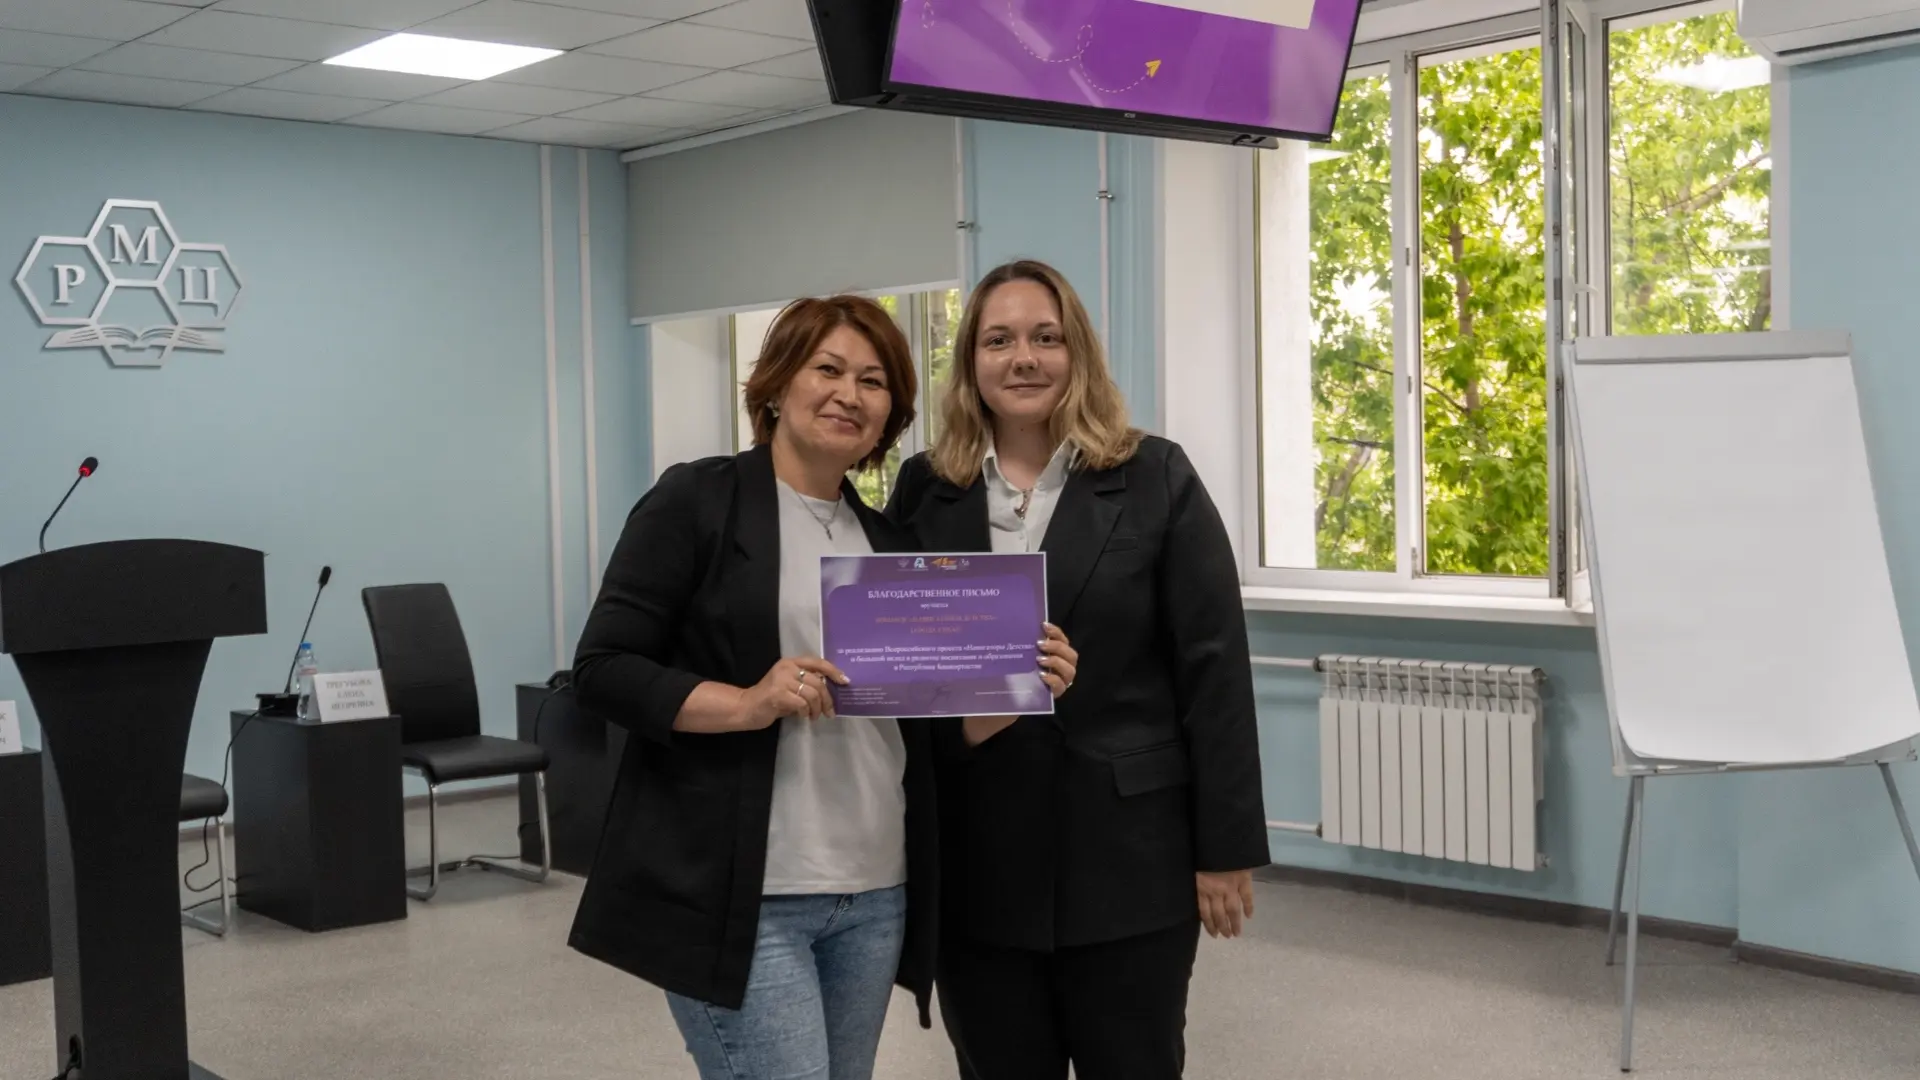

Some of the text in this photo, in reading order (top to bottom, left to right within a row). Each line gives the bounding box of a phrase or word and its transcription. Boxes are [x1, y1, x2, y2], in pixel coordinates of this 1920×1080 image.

[52, 223, 220, 317] РМЦ
[867, 588, 1000, 599] БЛАГОДАРСТВЕННОЕ ПИСЬМО
